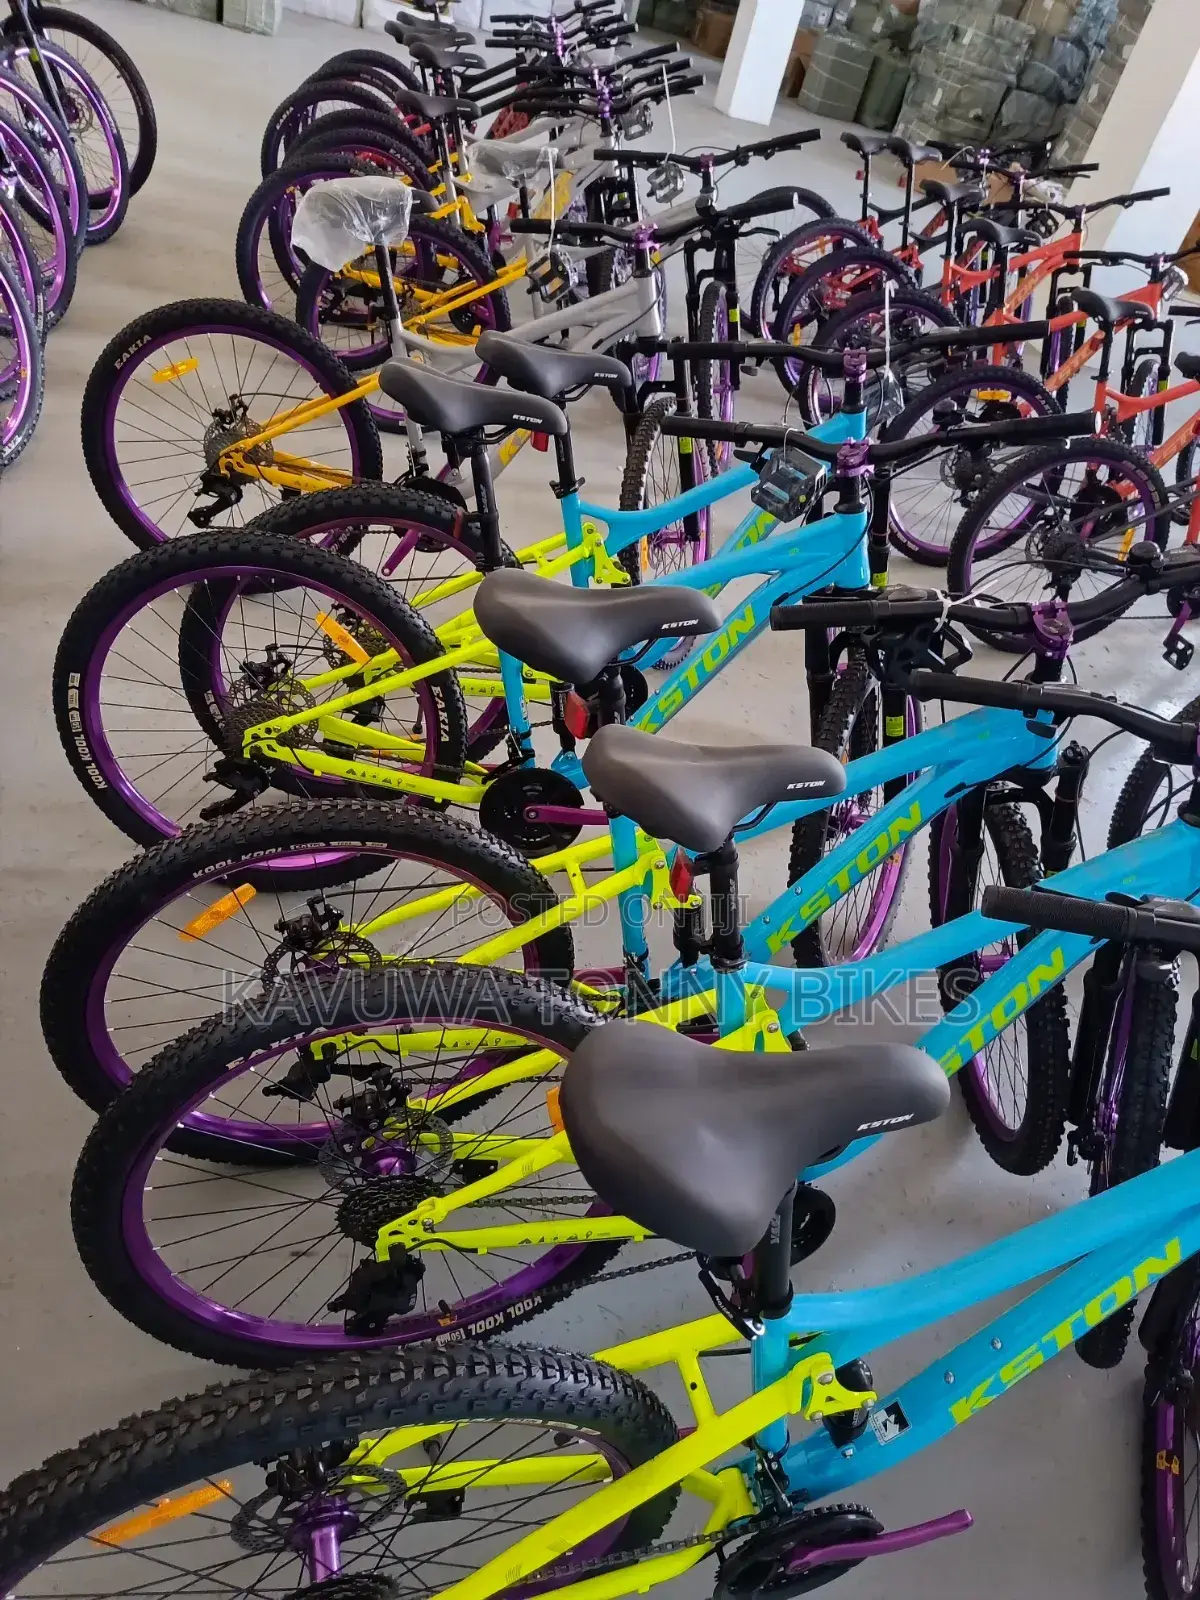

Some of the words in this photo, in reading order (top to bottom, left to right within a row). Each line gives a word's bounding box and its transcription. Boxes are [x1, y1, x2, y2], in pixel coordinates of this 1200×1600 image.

[512, 414, 543, 424] KSTON
[661, 618, 699, 630] KSTON
[634, 604, 756, 735] KSTON
[431, 685, 449, 742] EAKIA
[74, 733, 92, 761] KOOL
[86, 762, 108, 789] KOOL
[787, 780, 826, 790] KSTON
[193, 859, 237, 879] KOOL
[766, 800, 922, 956] KSTON
[937, 946, 1065, 1080] STON
[857, 1112, 915, 1131] KSTON
[507, 1295, 542, 1319] KOOL
[468, 1312, 505, 1336] KOOL
[949, 1235, 1182, 1424] KSTON
